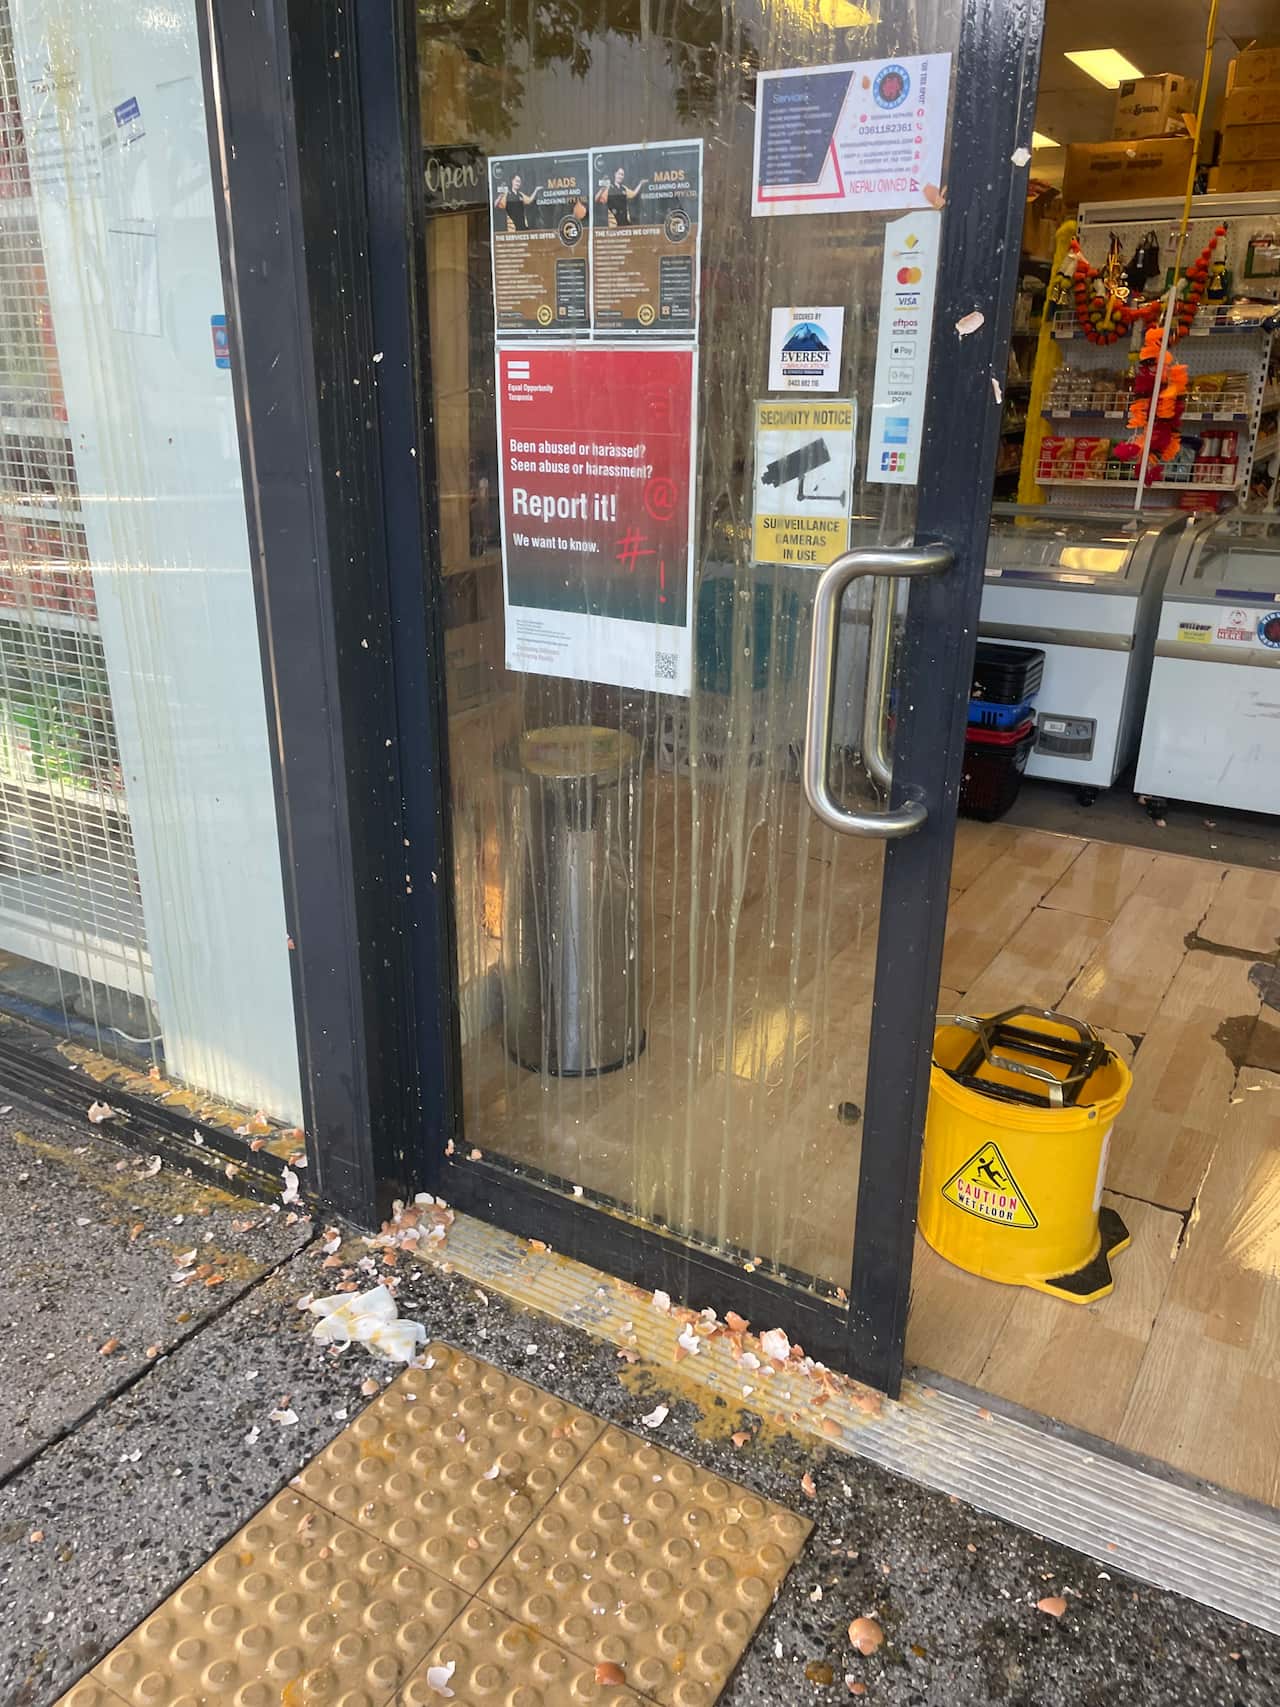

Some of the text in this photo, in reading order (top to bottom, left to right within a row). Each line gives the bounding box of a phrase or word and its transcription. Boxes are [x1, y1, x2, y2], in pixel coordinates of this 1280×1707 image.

[424, 158, 479, 200] Open
[547, 177, 576, 189] MADS
[654, 169, 685, 182] MADS
[849, 177, 906, 193] NEPALI OWNED
[898, 297, 917, 305] VISA
[893, 318, 918, 328] eftpos
[781, 351, 830, 362] EVEREST
[508, 384, 554, 394] Equal Opportunity
[760, 410, 851, 425] SECURITY NOTICE
[510, 438, 646, 459] Been abused or harassed?
[510, 458, 653, 479] Seen abuse or harassment?
[881, 451, 906, 472] JCB
[512, 487, 617, 523] Report it!
[512, 533, 600, 553] We want to know.
[776, 534, 826, 547] CAMERAS
[783, 549, 817, 560] IN USE
[957, 1178, 1017, 1210] CAUTION
[958, 1193, 1013, 1220] WET FLOOR
